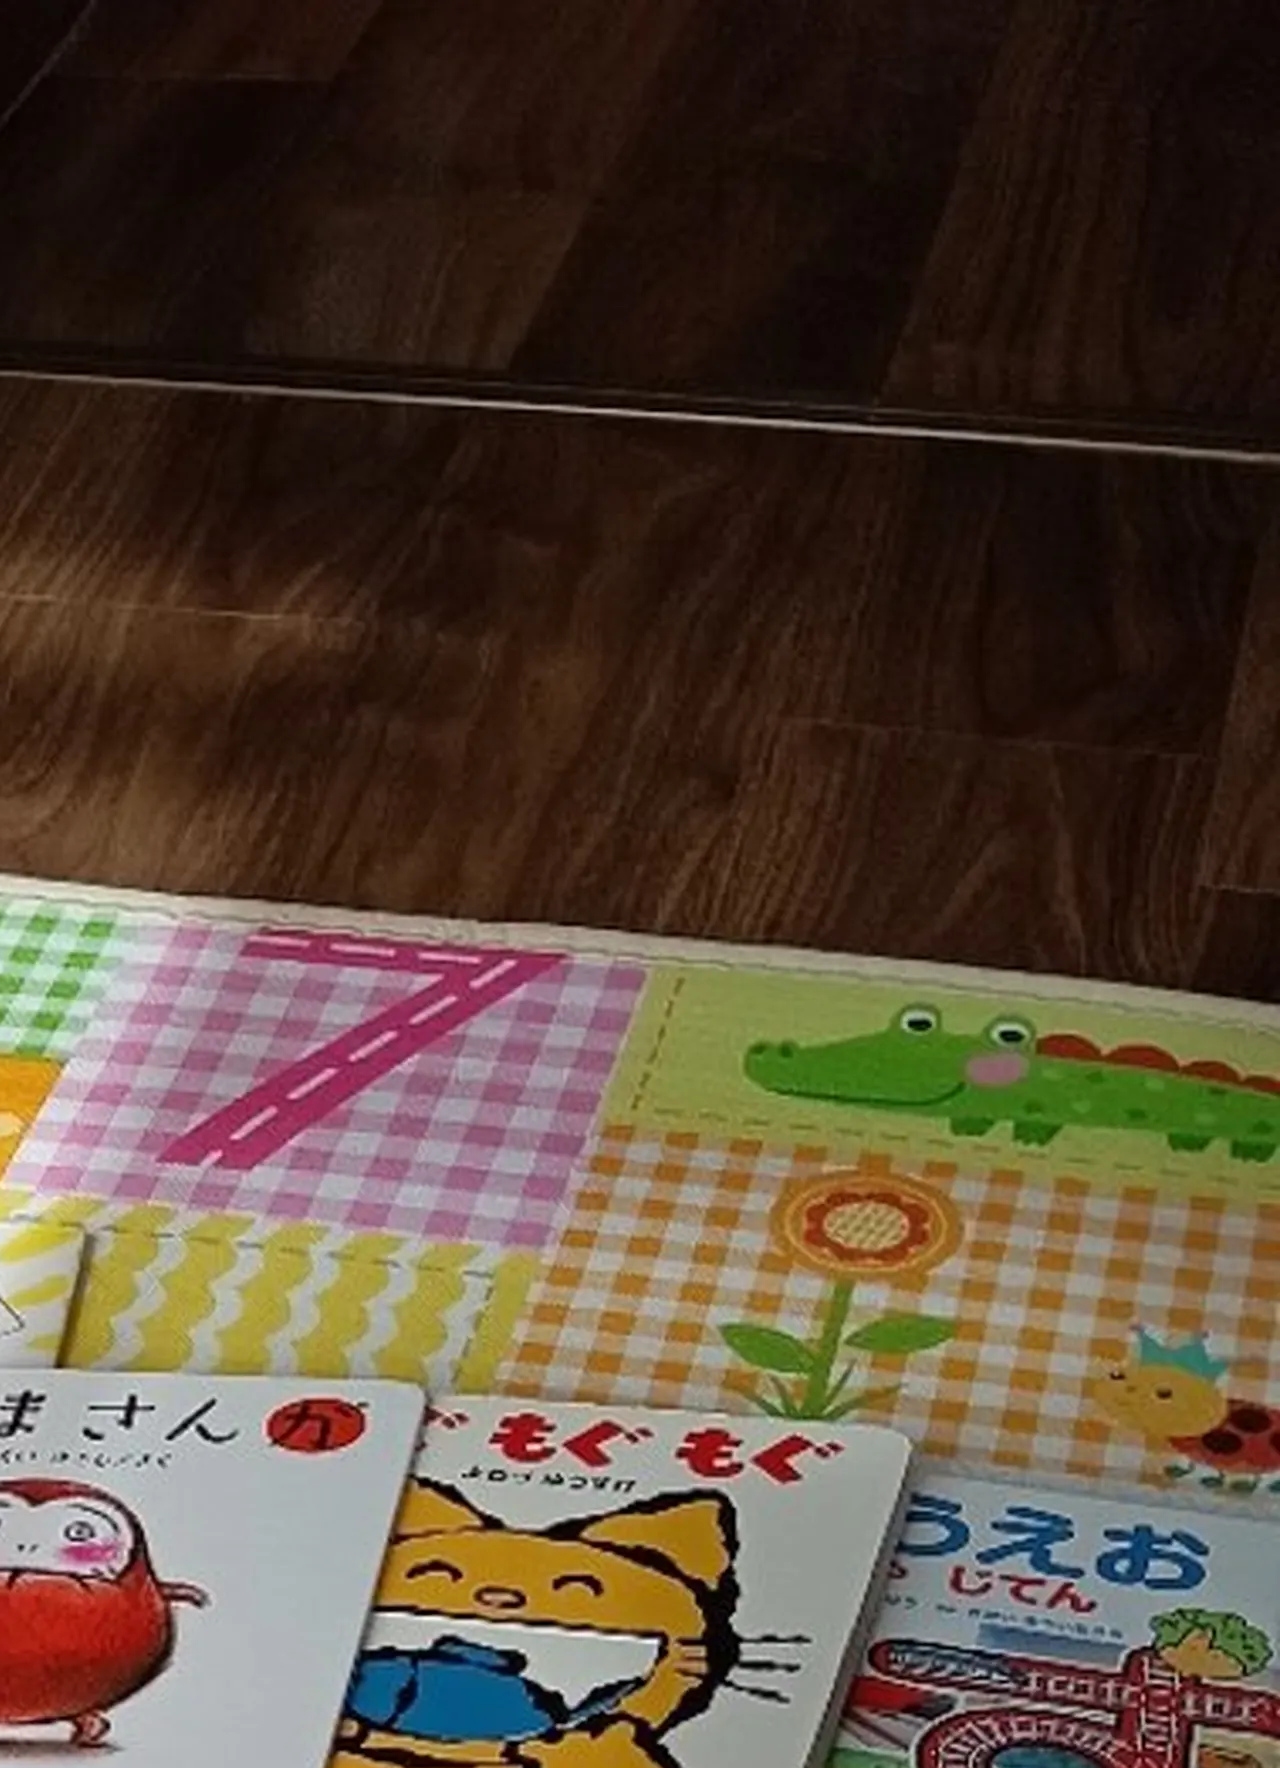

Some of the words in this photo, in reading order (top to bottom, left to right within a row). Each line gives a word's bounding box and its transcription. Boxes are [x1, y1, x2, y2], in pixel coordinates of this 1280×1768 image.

[156, 929, 571, 1168] 7
[895, 1492, 1210, 1590] うえお
[950, 1566, 1097, 1614] じてん
